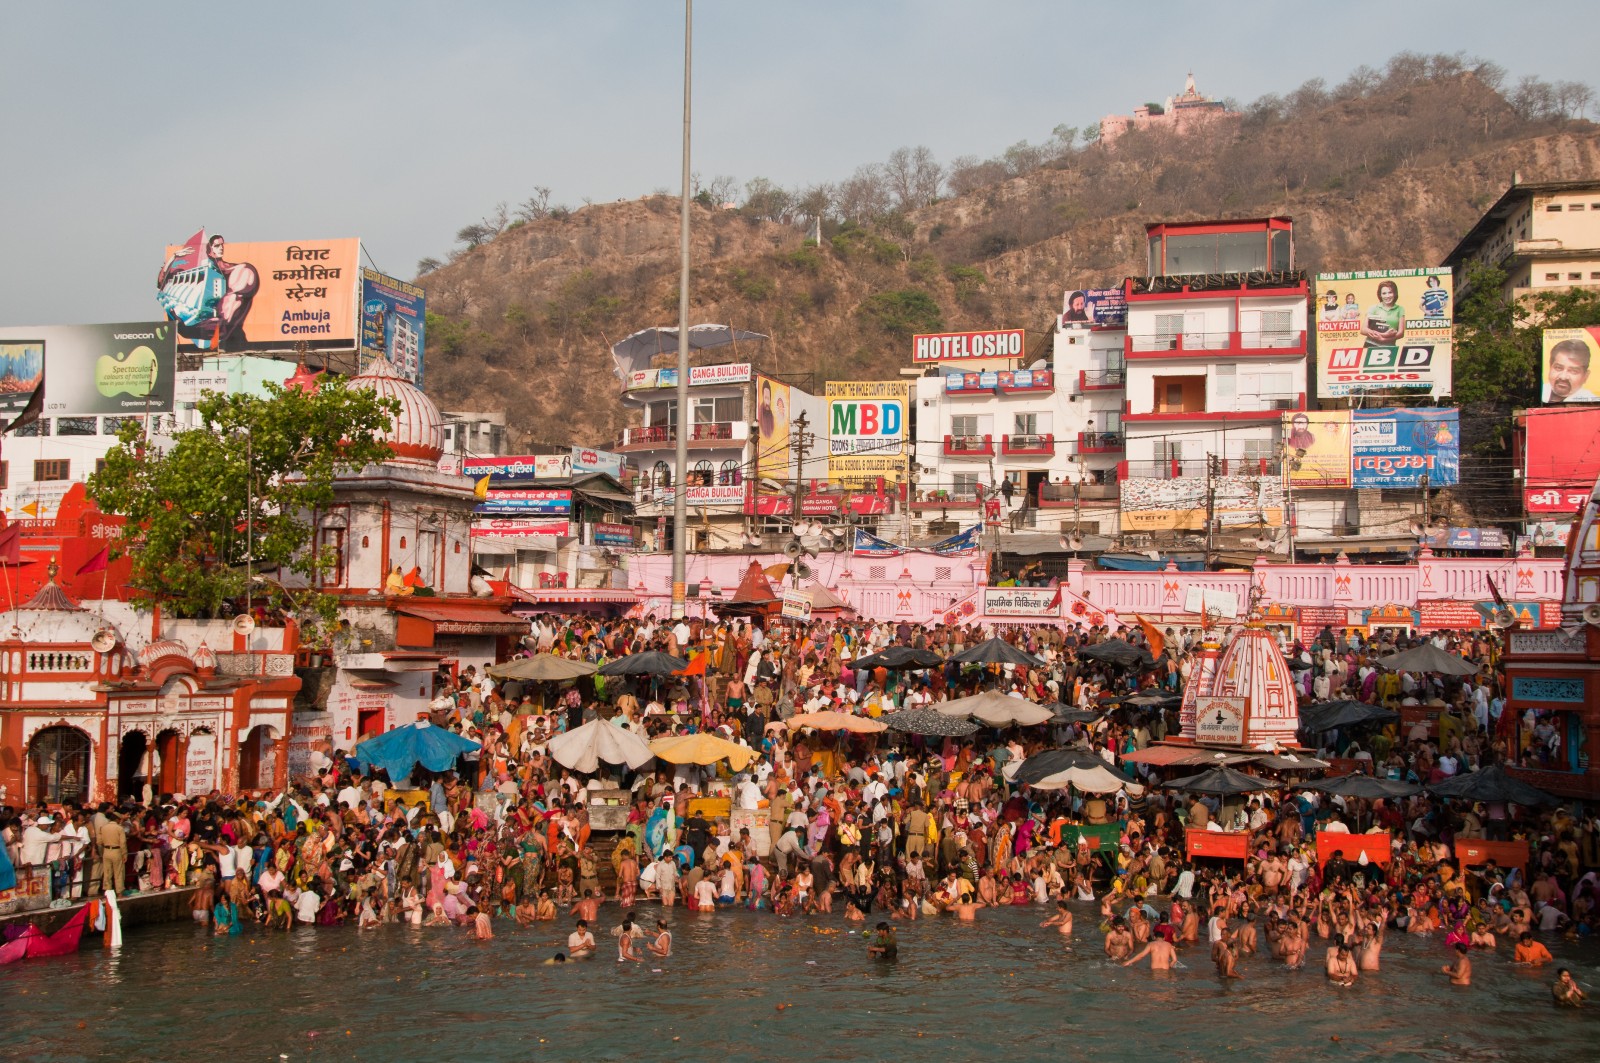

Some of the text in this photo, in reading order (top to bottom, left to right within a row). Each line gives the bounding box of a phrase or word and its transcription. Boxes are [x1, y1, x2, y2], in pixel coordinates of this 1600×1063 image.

[286, 246, 331, 261] विराट
[272, 264, 342, 281] कम्प्रेसिव
[1336, 272, 1352, 280] WHAT
[1355, 271, 1366, 279] THE
[1367, 270, 1388, 278] WHOLE
[1389, 268, 1416, 277] COUNTRY
[1426, 267, 1452, 275] READING
[282, 309, 331, 323] Ambuja
[281, 323, 331, 335] Cement
[1319, 321, 1359, 331] HOLY FAITH
[1406, 319, 1451, 329] MODERN
[917, 332, 1022, 359] HOTEL OSHO
[1332, 347, 1430, 367] MBD
[112, 366, 150, 374] Spectacular
[692, 364, 749, 379] GANGA BUILDING
[1338, 373, 1420, 382] BOOKS
[827, 382, 837, 396] READ
[868, 382, 886, 396] COUNTRY
[891, 382, 907, 396] READING
[832, 403, 901, 435] MBD
[832, 440, 849, 452] BOOKS
[508, 460, 535, 478] पुलिस
[686, 487, 743, 498] GANGA BUILDING
[1530, 490, 1562, 505] श्री
[91, 523, 104, 539] श्री
[987, 596, 1013, 608] प्राथमिक
[1014, 597, 1041, 608] चिकित्सा
